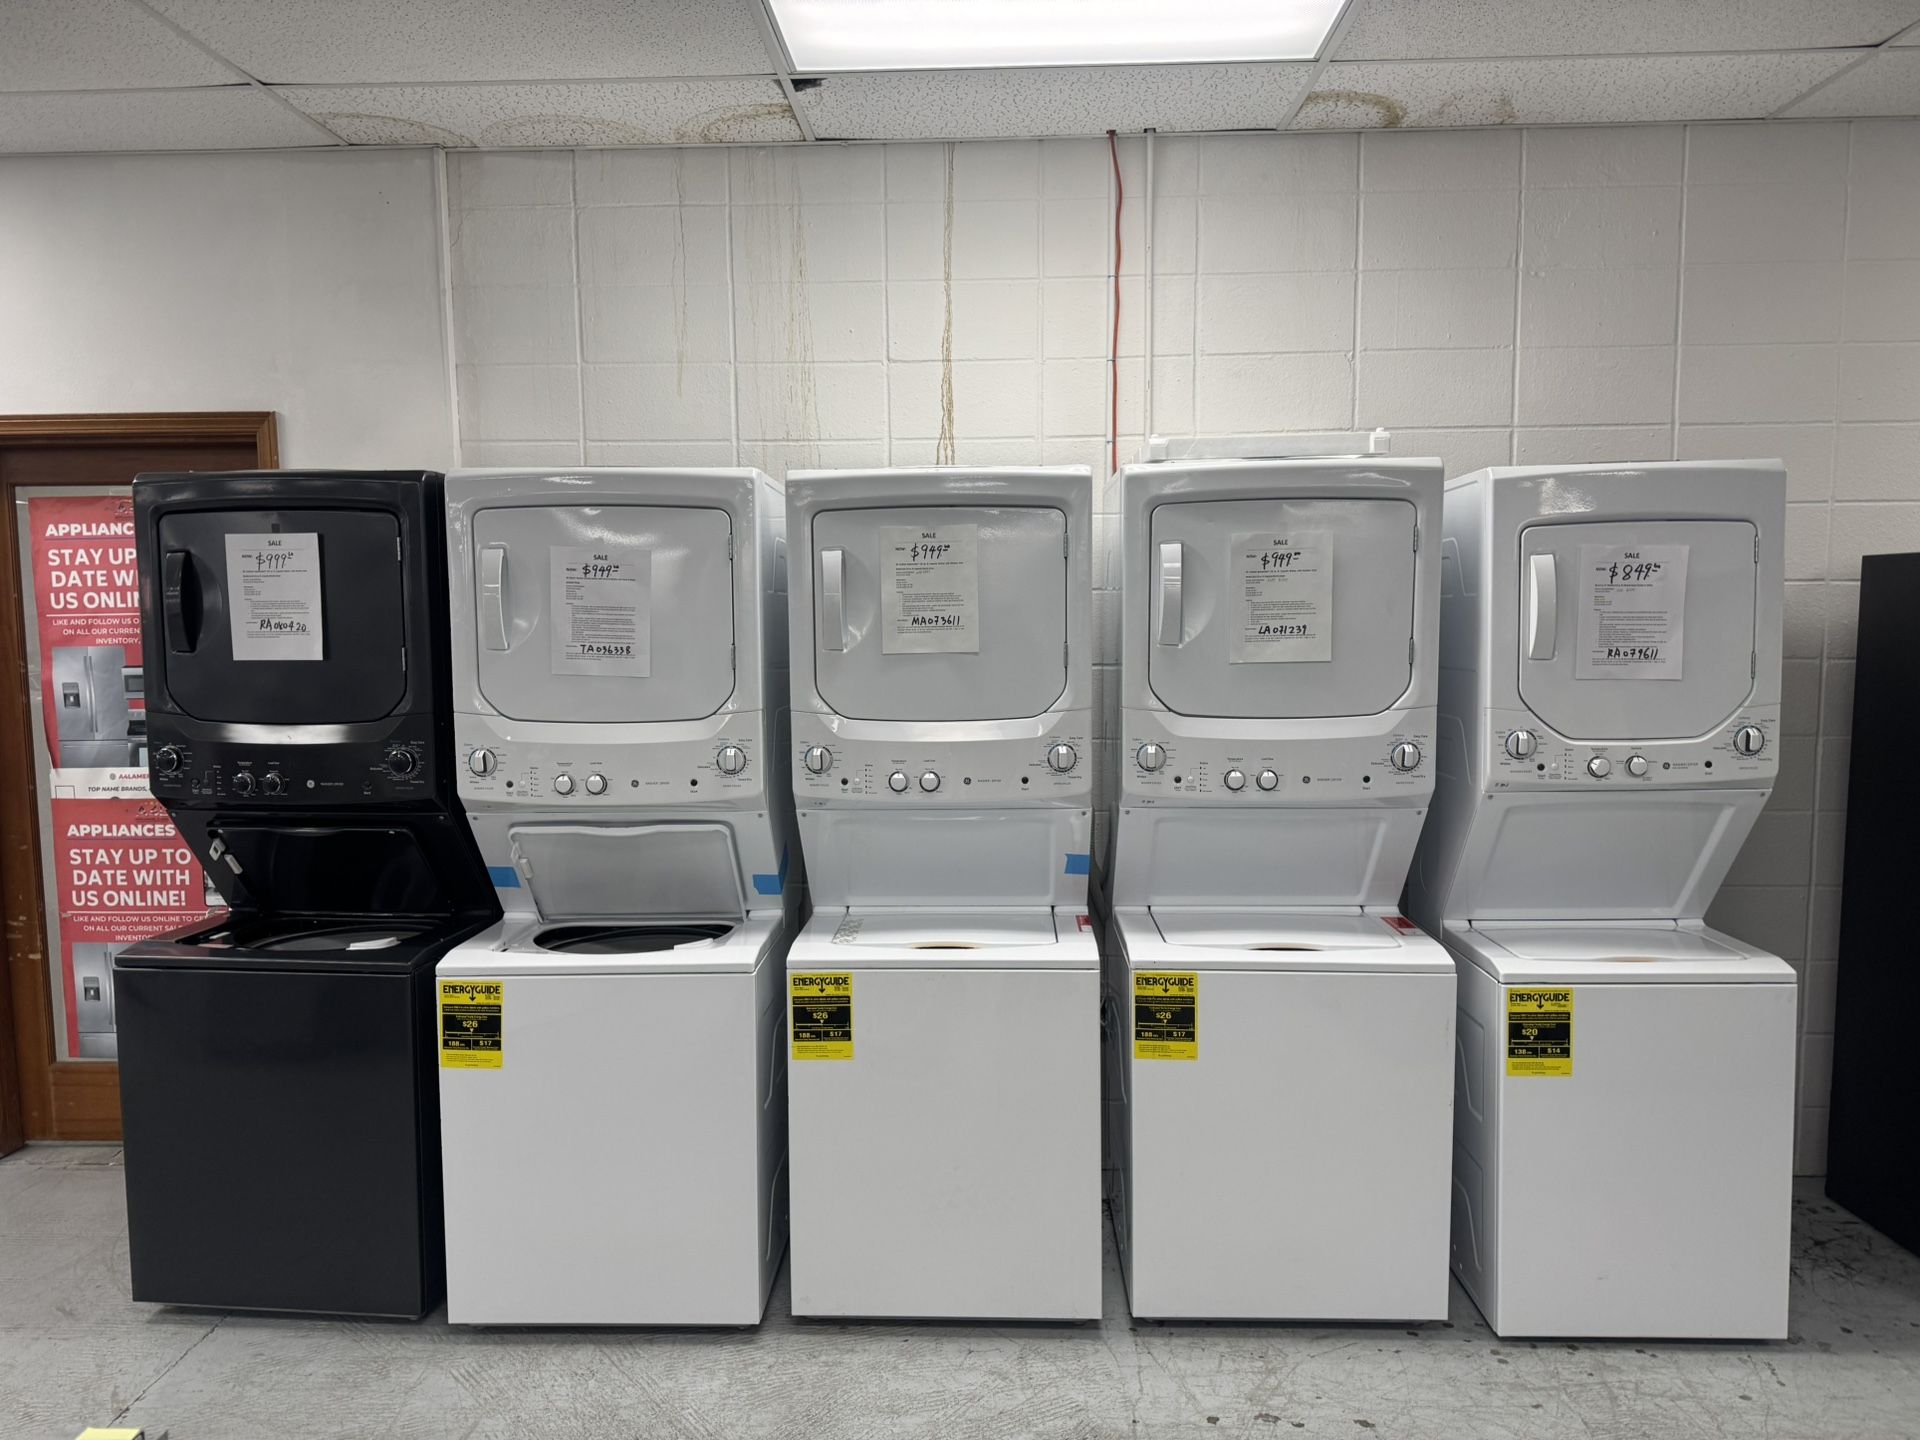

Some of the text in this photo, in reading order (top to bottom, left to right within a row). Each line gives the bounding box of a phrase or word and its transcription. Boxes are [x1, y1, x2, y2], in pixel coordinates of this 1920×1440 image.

[48, 548, 137, 566] STAY UP
[51, 570, 108, 588] DATE
[50, 591, 78, 609] US
[52, 618, 68, 626] LIKE
[911, 615, 960, 626] MA073611
[67, 824, 176, 837] APPLIANCES
[69, 848, 192, 865] STAY UP TO
[72, 869, 190, 886] DATE WITH
[71, 890, 186, 907] US ONLINE!
[793, 977, 849, 986] ENERGYGUIDE
[1136, 977, 1194, 986] ENERGYGUIDE
[443, 985, 501, 994] ENERGYGUIDE
[1510, 993, 1570, 1002] ENERGYGUIDE
[1521, 1028, 1538, 1036] $20
